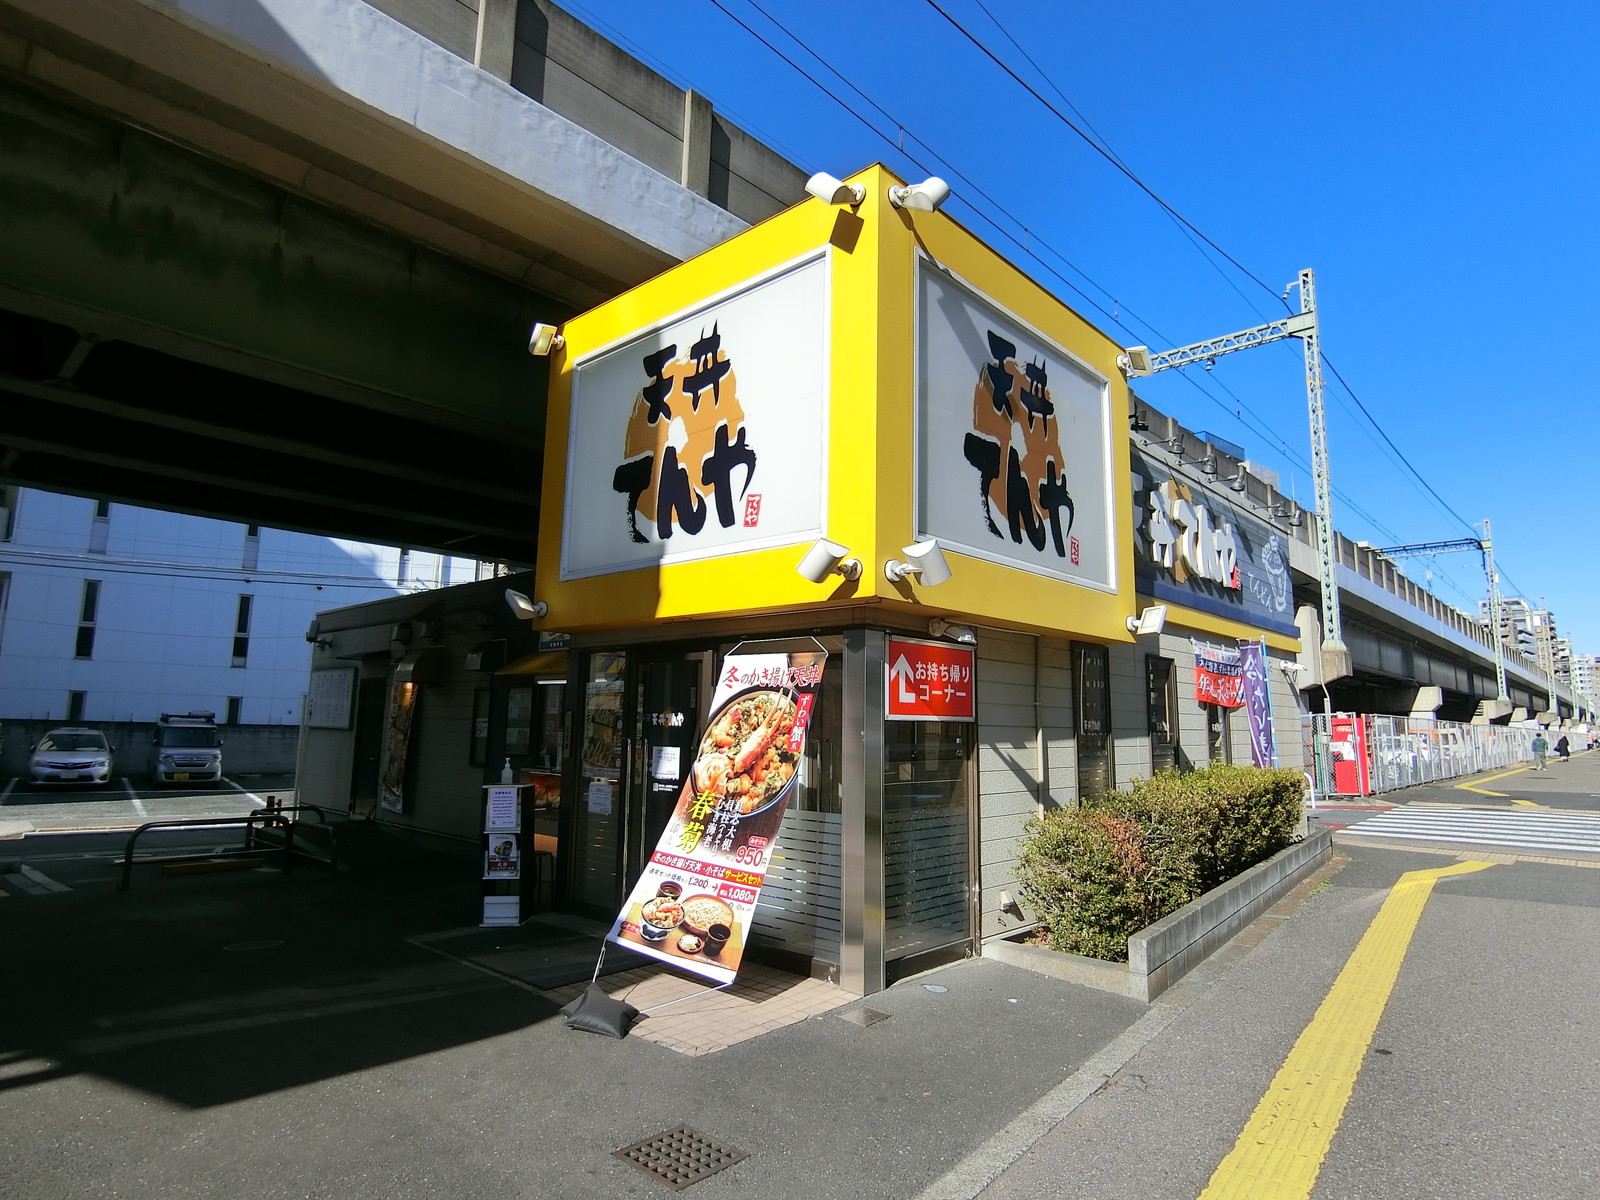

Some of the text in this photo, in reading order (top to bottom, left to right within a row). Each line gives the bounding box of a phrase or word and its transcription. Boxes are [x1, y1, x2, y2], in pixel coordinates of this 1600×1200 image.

[643, 319, 731, 426] 天丼
[987, 329, 1055, 439] 天丼
[612, 420, 758, 545] てんや
[744, 494, 761, 526] てんや
[963, 431, 1075, 559] てんや
[722, 664, 821, 689] 冬のかき揚げ天丼
[915, 660, 970, 684] お持ち帰り
[919, 684, 967, 703] コーナー
[675, 789, 717, 855] 春菊
